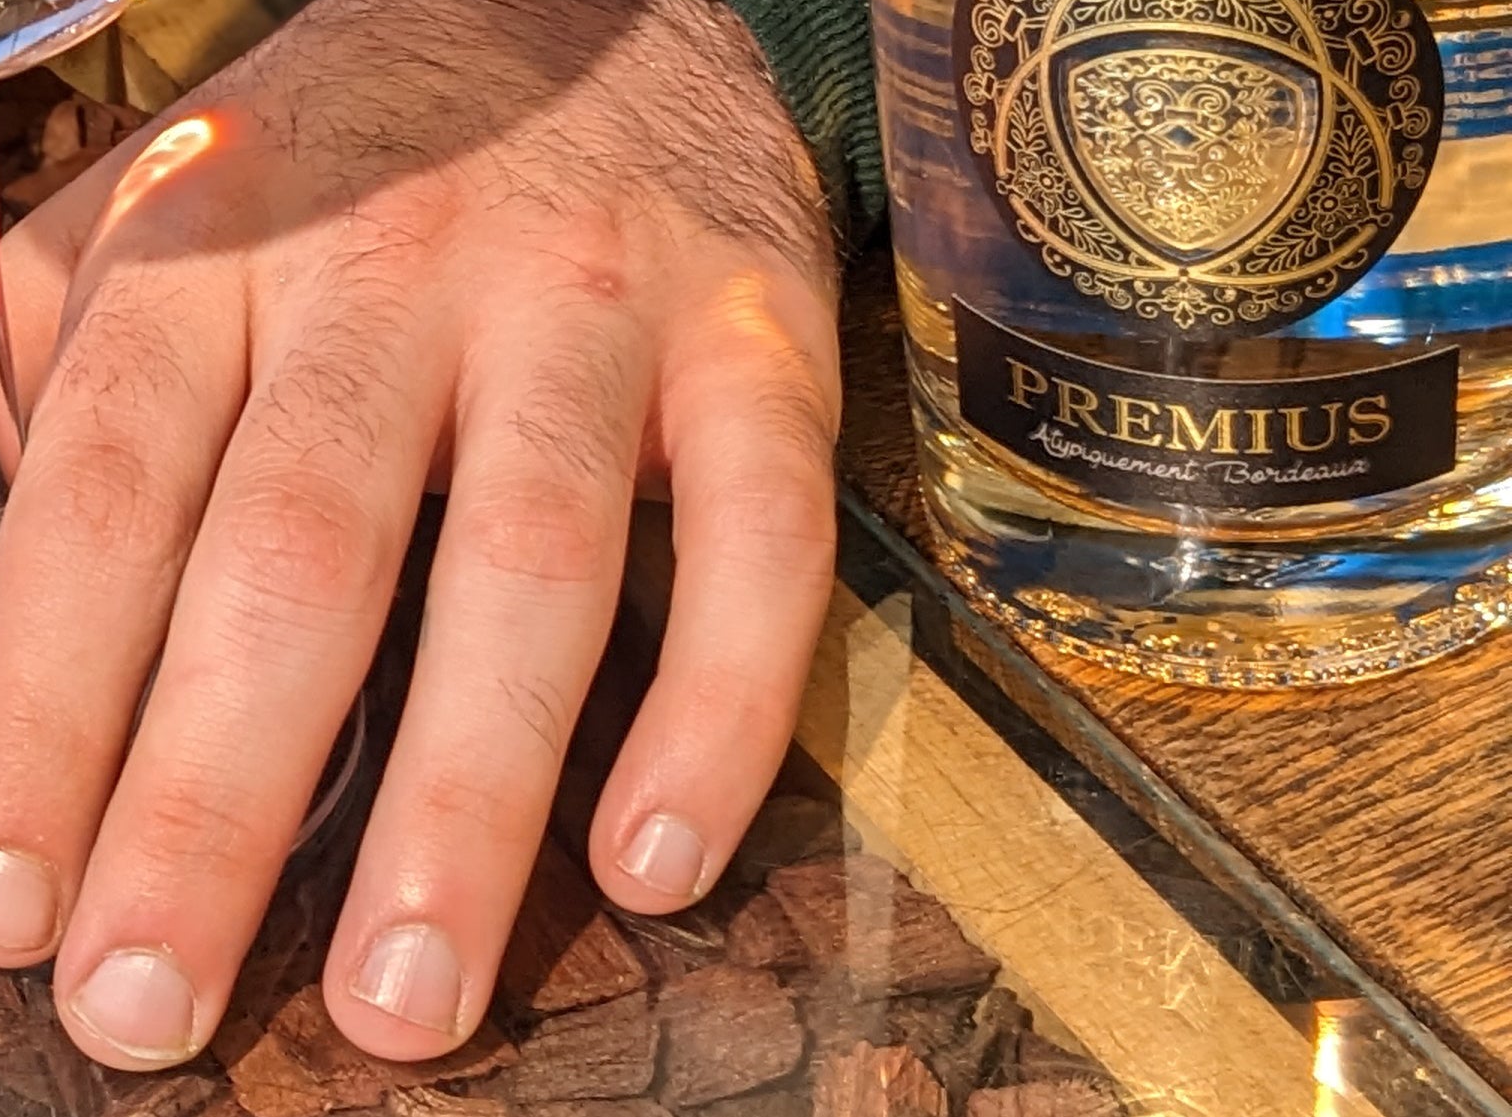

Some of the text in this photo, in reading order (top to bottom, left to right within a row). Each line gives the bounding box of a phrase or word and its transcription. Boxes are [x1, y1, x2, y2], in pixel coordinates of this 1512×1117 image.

[1004, 355, 1393, 455] PREMIUS
[1029, 421, 1372, 485] Atypiquement Bordeaux
